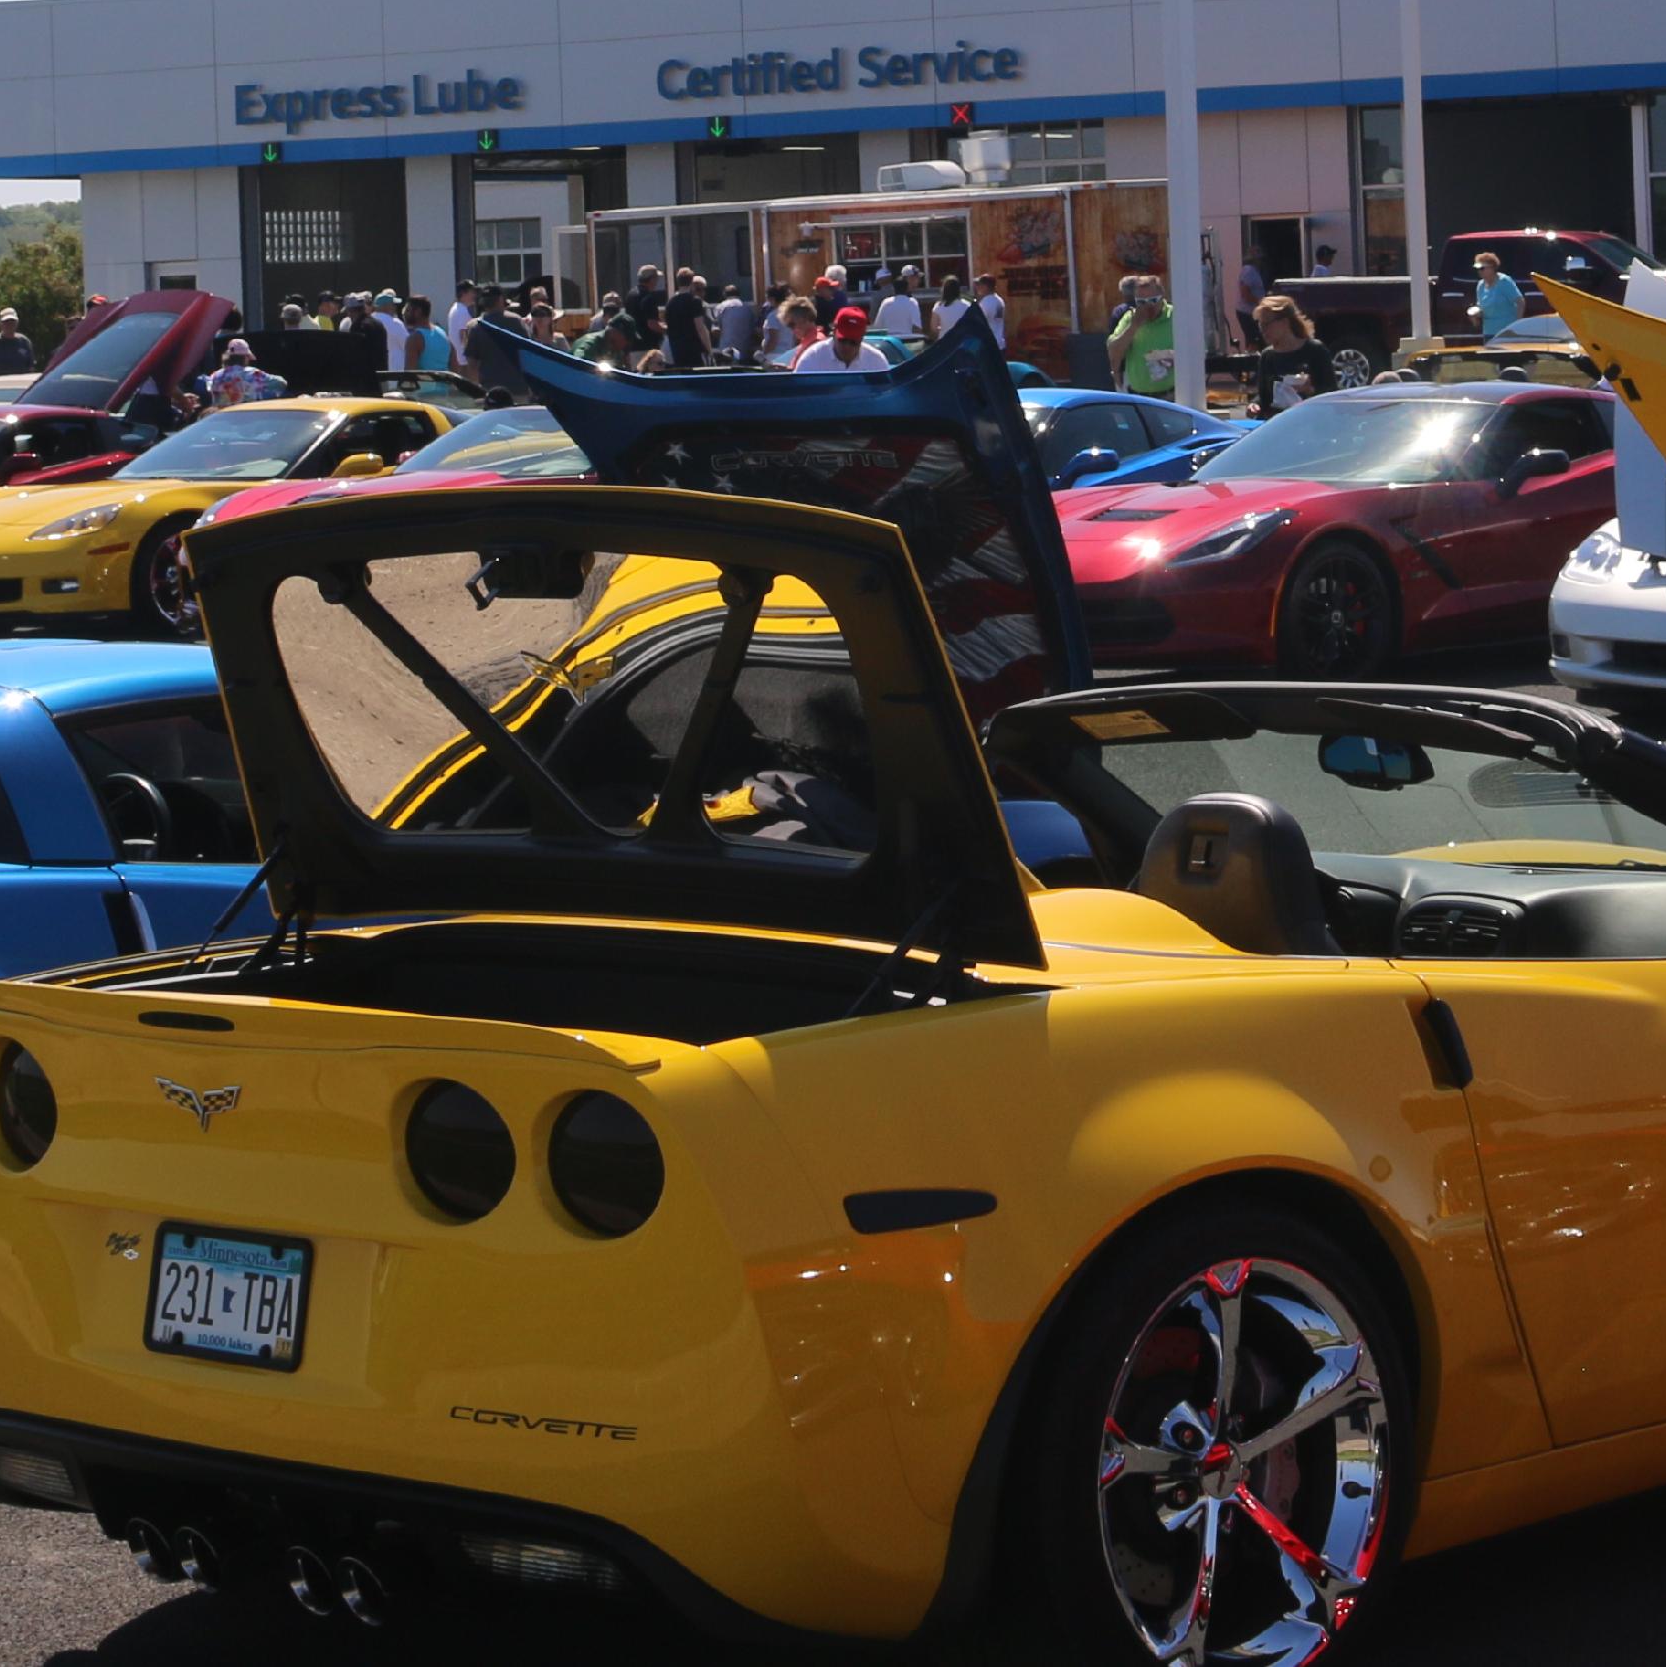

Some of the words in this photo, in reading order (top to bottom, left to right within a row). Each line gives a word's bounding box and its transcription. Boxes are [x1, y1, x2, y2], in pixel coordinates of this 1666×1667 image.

[657, 47, 840, 99] Certified
[858, 40, 1019, 87] Service
[235, 84, 408, 135] Express
[413, 69, 526, 115] Lube
[711, 449, 900, 472] CORVETTE
[161, 1261, 214, 1325] 231
[243, 1271, 293, 1337] TBA
[449, 1405, 638, 1441] CORVETTE
